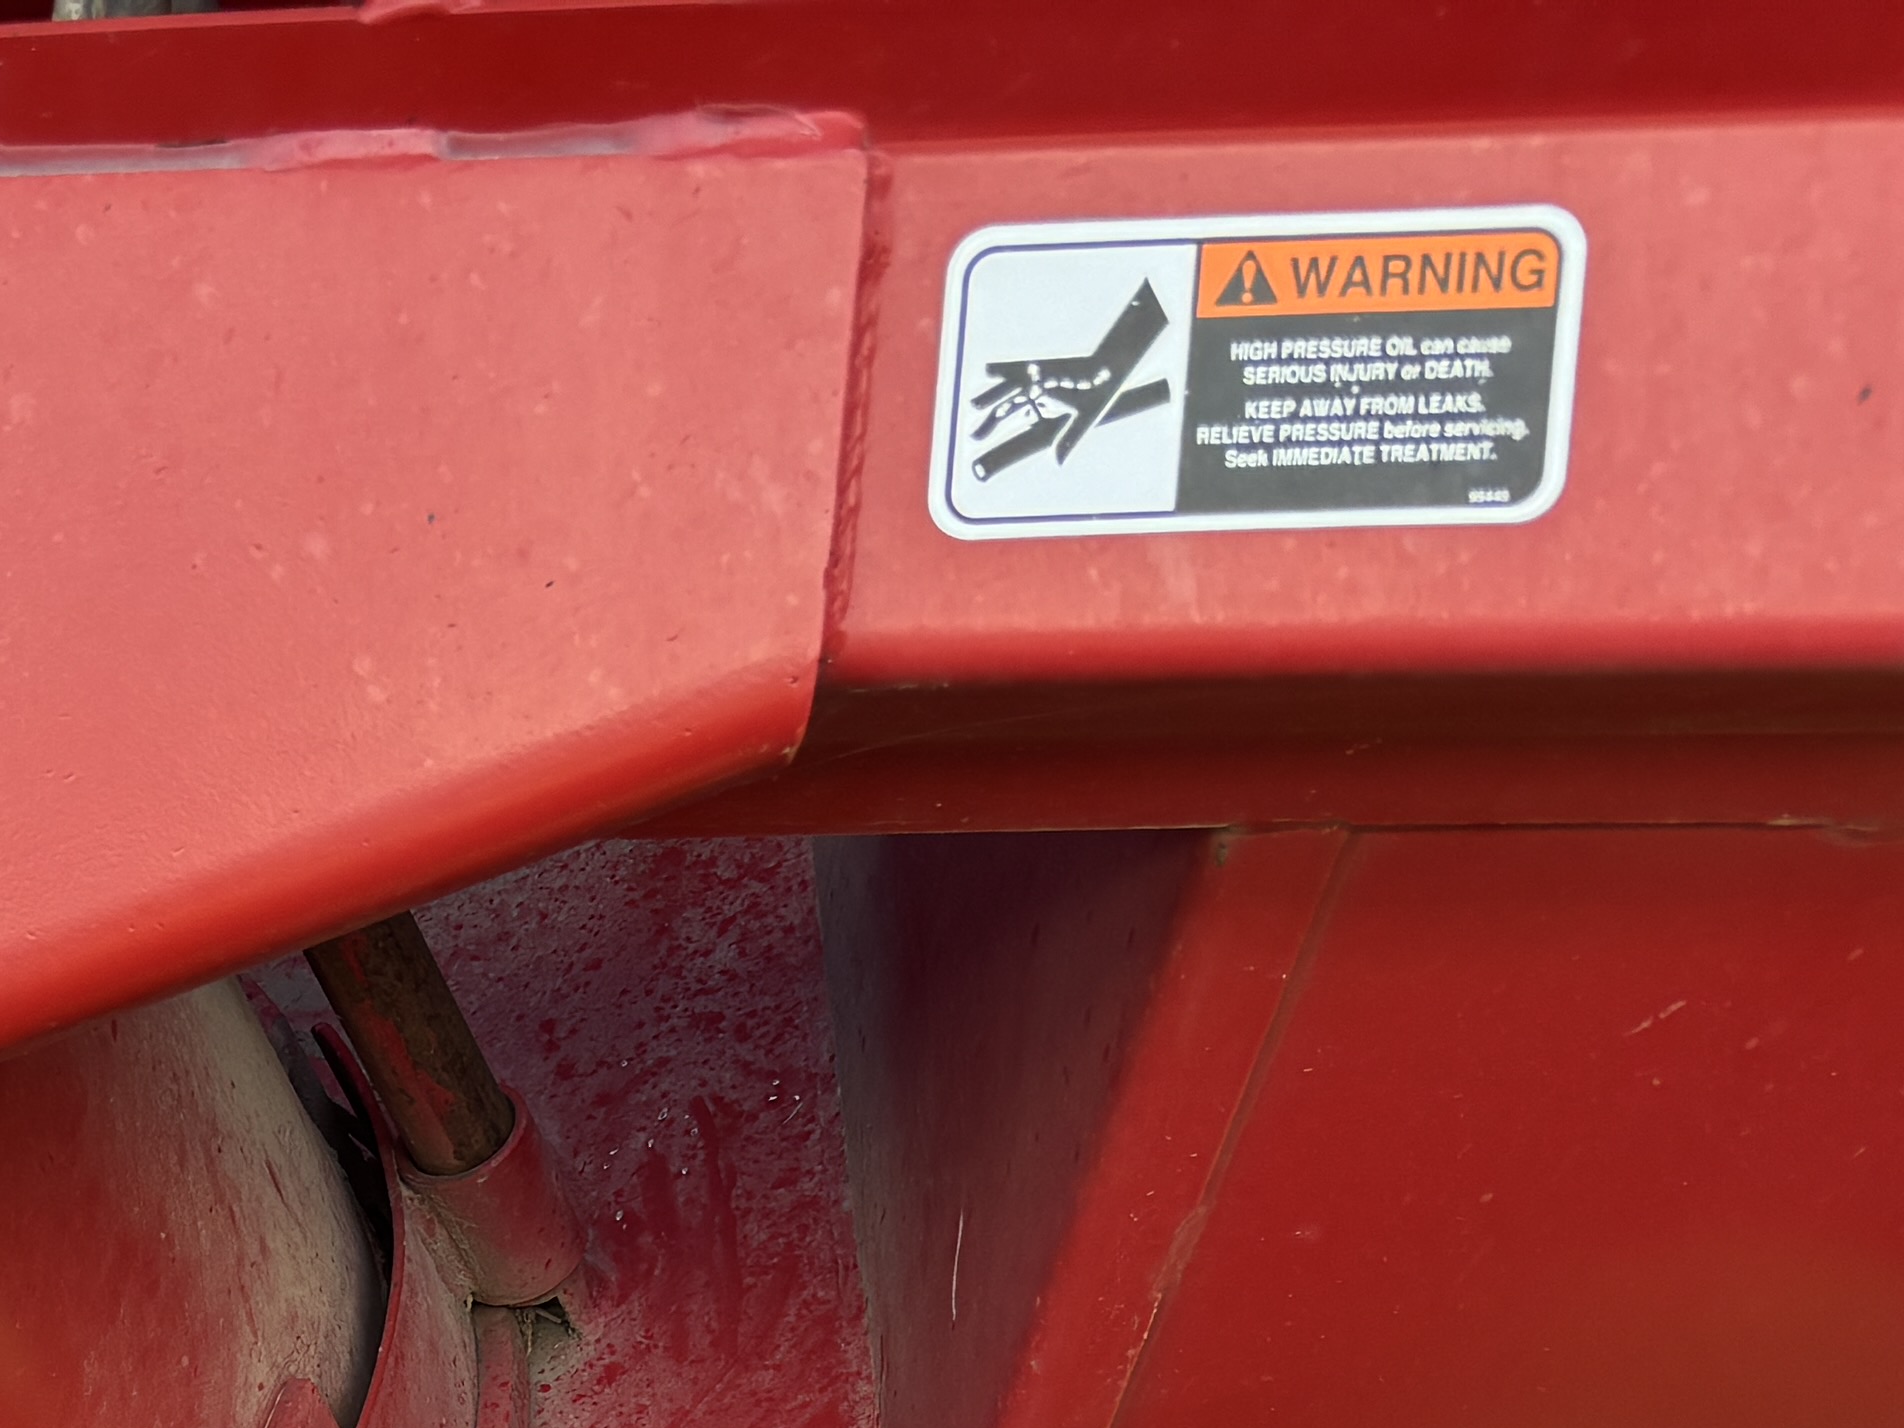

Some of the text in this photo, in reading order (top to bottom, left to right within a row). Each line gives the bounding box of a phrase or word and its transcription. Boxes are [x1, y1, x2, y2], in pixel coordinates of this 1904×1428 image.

[1290, 248, 1548, 299] WARNING
[1230, 336, 1512, 361] HIGH PRESSURE OIL can cause
[1243, 359, 1494, 385] SERIOUS INJURY or DEATH.
[1244, 392, 1486, 419] KEEP AWAY FROM LEAKS.
[1197, 418, 1530, 445] RELIEVE PRESSURE before servicing.
[1224, 443, 1497, 468] Seek IMMEDIATE TREATMENT.
